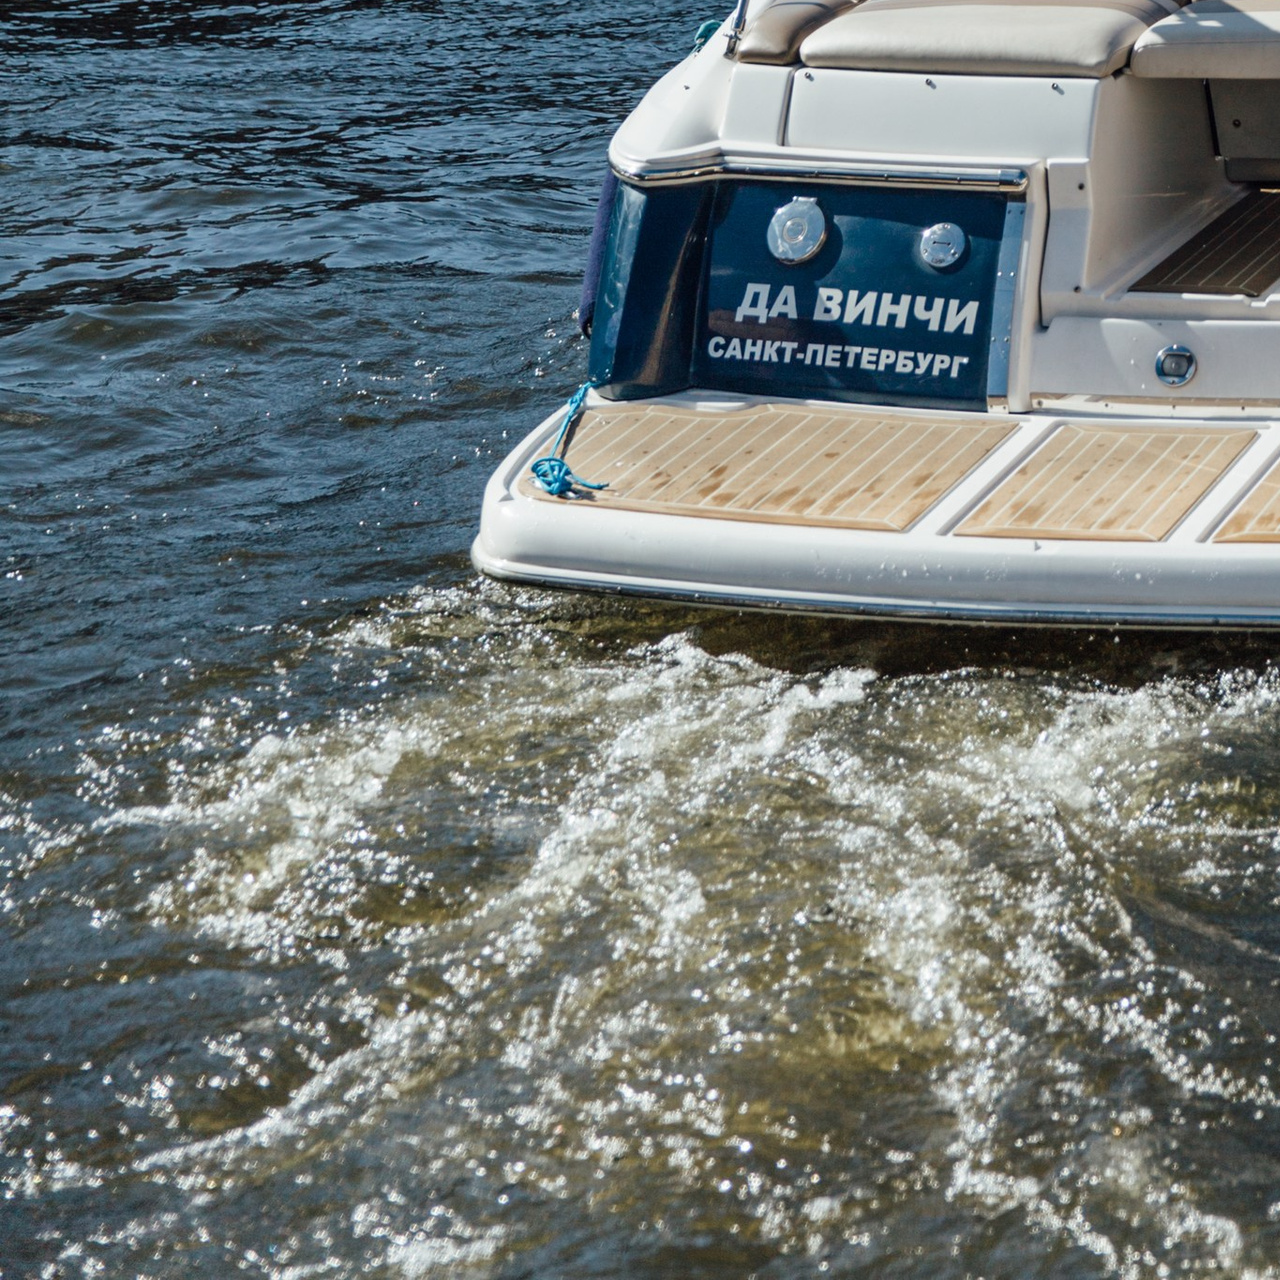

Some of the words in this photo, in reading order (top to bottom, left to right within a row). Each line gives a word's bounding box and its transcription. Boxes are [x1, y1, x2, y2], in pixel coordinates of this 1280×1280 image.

[735, 282, 798, 324] ДА
[813, 287, 980, 335] ВИНЧИ
[707, 335, 970, 379] САНКТ-ПЕТЕРБУРГ
